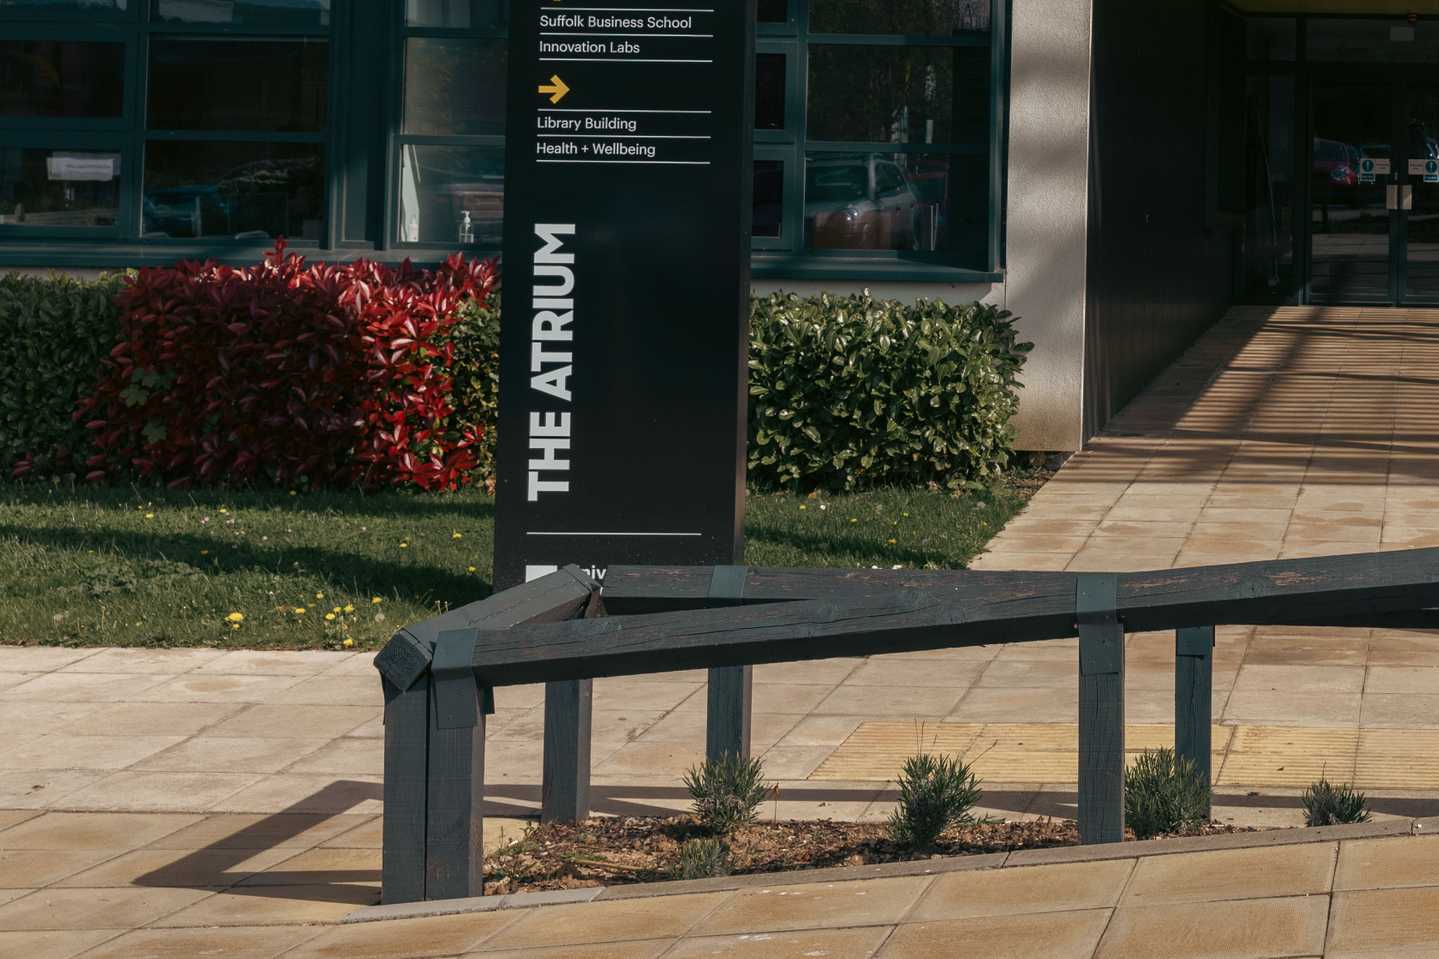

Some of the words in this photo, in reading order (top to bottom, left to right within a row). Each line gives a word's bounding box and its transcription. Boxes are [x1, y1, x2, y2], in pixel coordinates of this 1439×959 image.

[539, 15, 584, 28] Suffolk
[587, 16, 644, 29] Business
[646, 16, 692, 29] School
[539, 41, 606, 54] Innovation
[609, 41, 641, 54] Labs
[537, 116, 582, 132] Library
[584, 117, 637, 132] Building
[536, 142, 578, 155] Health
[592, 142, 656, 157] Wellbeing
[530, 223, 576, 402] ATRIUM
[527, 411, 572, 502] THE
